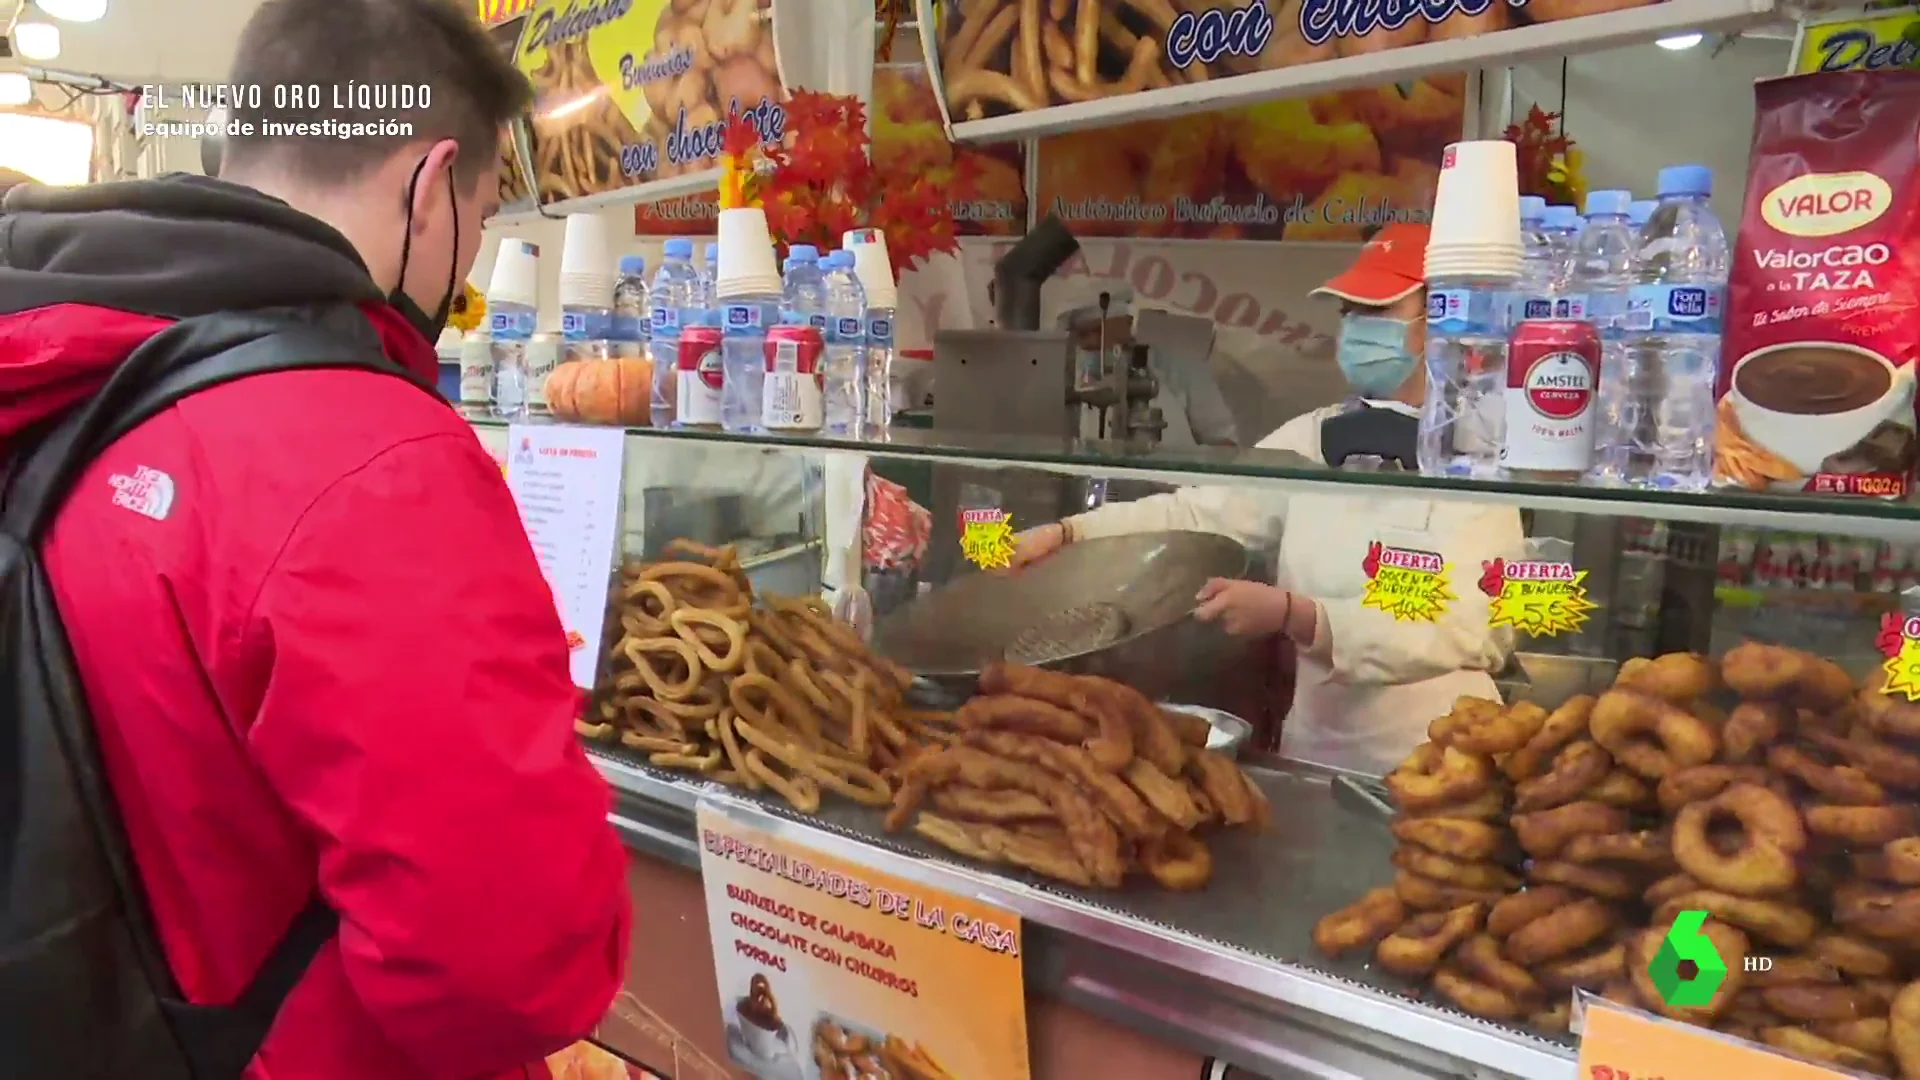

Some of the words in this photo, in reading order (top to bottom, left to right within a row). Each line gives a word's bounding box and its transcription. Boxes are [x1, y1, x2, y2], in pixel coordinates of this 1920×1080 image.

[1168, 0, 1272, 67] con
[621, 144, 657, 176] con
[1283, 192, 1316, 224] de
[1778, 189, 1873, 218] VALOR
[1791, 269, 1875, 291] TAZA
[1540, 391, 1580, 400] CERVEZA
[1382, 551, 1440, 570] OFERTA
[1507, 564, 1573, 578] OFERTA
[704, 829, 872, 908] ESPECIALIDADES
[876, 887, 910, 921] DE
[914, 900, 947, 934] LA
[951, 913, 1019, 958] CASA
[726, 883, 796, 923] BUÑUELOS
[799, 910, 818, 932] DE
[820, 922, 898, 961] CALABAZA
[731, 911, 808, 954] CHOCOLATE
[810, 943, 842, 967] CON
[845, 955, 919, 998] CHURROS
[734, 939, 787, 973] PORRAS
